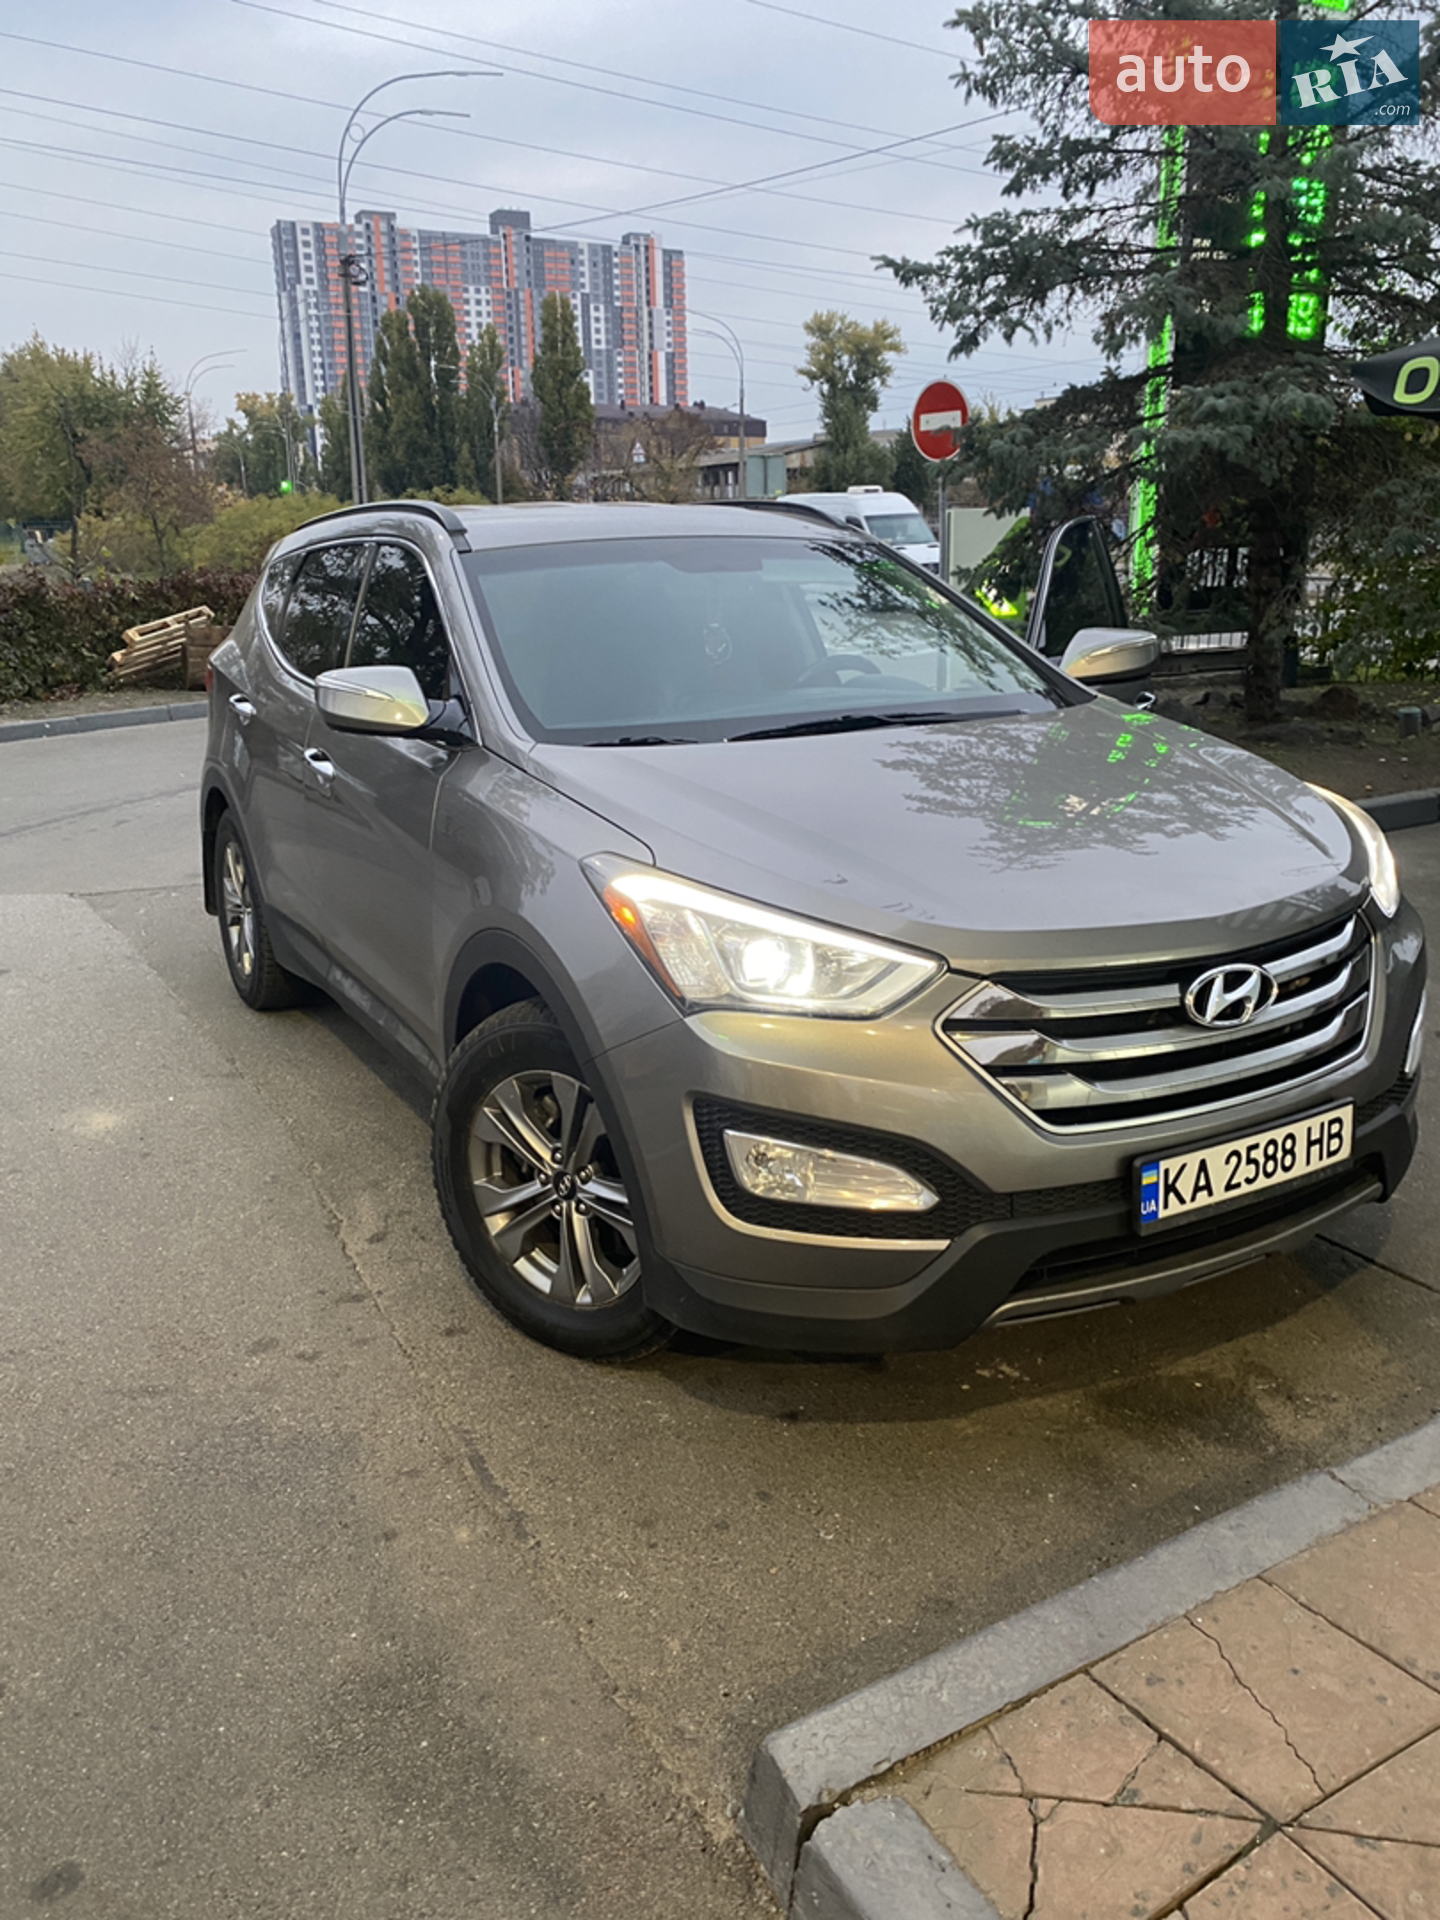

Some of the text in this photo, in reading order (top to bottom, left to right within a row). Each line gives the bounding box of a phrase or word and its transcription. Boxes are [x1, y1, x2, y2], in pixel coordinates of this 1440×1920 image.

[1162, 1116, 1344, 1210] KA 2588 HB
[1140, 1198, 1158, 1215] UA
